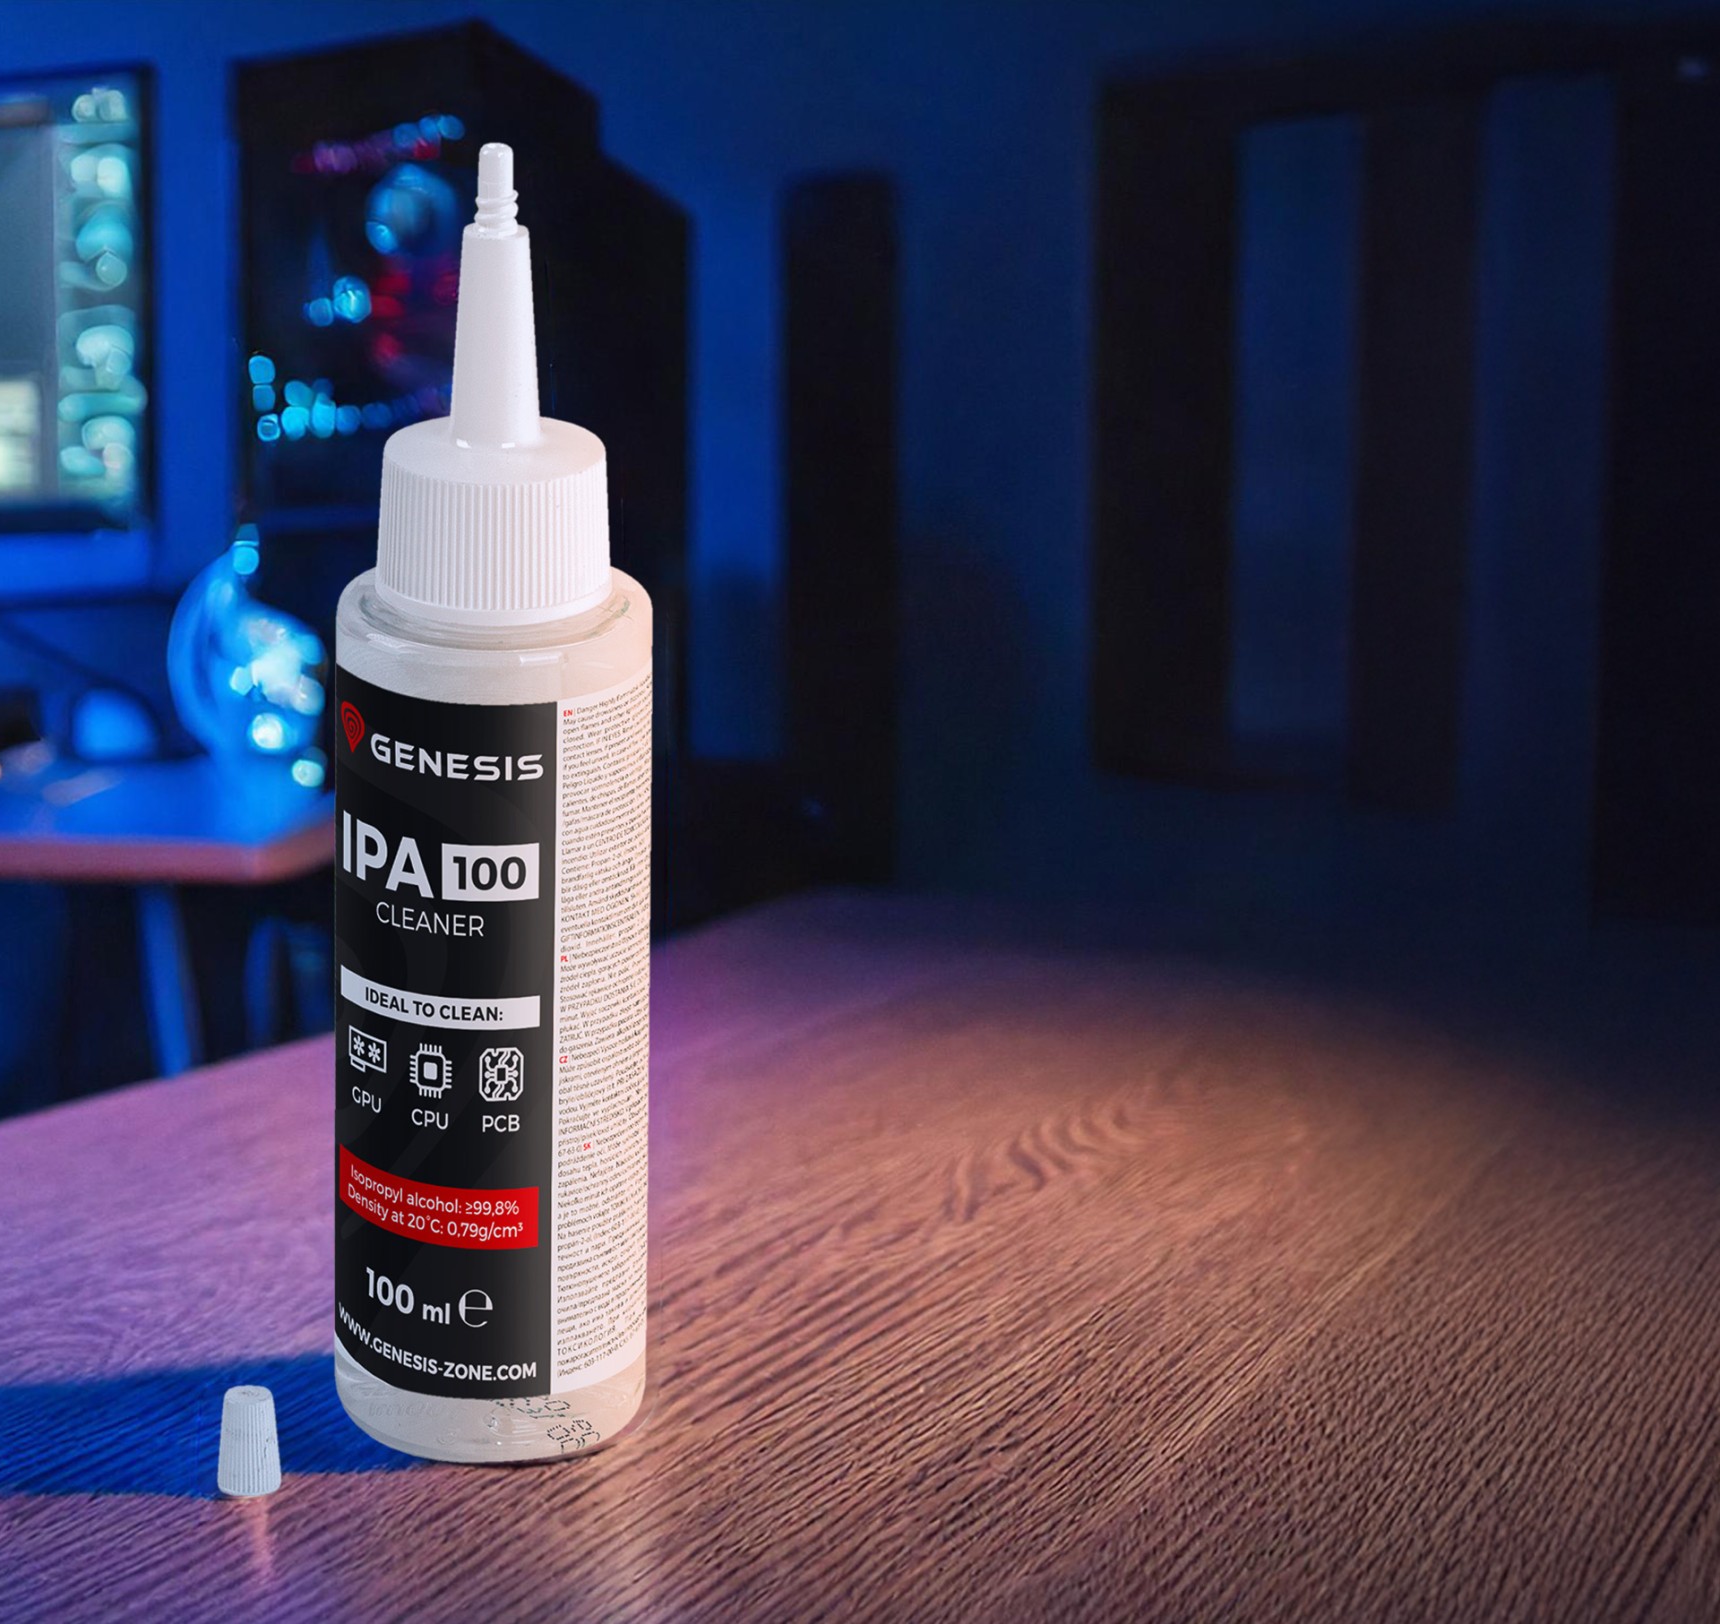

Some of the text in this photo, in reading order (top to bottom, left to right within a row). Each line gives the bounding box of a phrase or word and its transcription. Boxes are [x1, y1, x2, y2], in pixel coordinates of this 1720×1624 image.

[370, 733, 544, 781] GENESIS
[343, 810, 527, 899] IPA 100
[376, 901, 484, 937] CLEANER
[365, 986, 504, 1021] IDEAL TO CLEAN:
[559, 1055, 568, 1064] CZ
[352, 1086, 520, 1132] GPU CPU PCB
[347, 1183, 389, 1222] Density
[391, 1210, 404, 1225] at
[351, 1165, 520, 1218] Isopropyl alcohol: ≥99,8%
[366, 1266, 415, 1314] 100
[422, 1301, 450, 1325] ml
[338, 1301, 537, 1381] WWW.GENESIS-ZONE.COM
